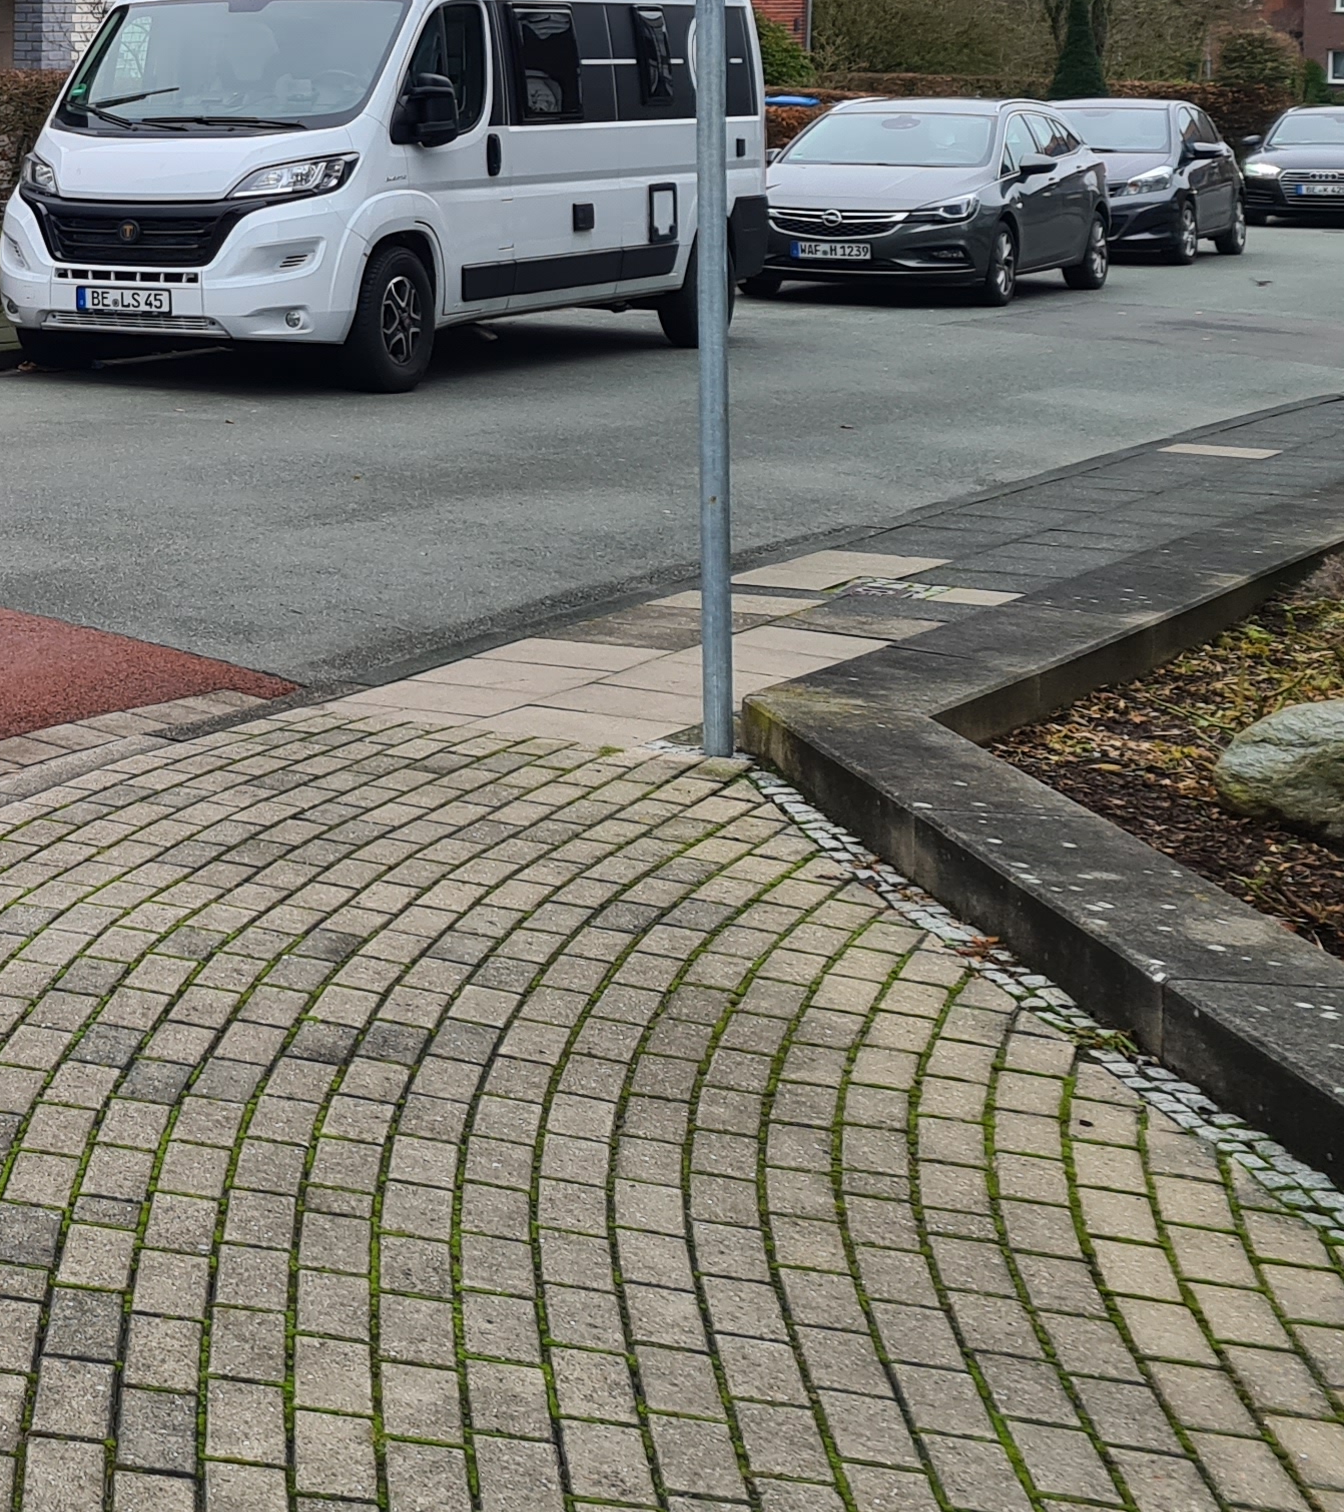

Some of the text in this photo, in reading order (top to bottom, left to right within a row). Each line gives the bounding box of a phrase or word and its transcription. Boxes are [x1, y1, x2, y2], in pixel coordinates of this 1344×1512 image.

[799, 244, 869, 257] WAF H 1239
[91, 290, 164, 310] BE LS 45
